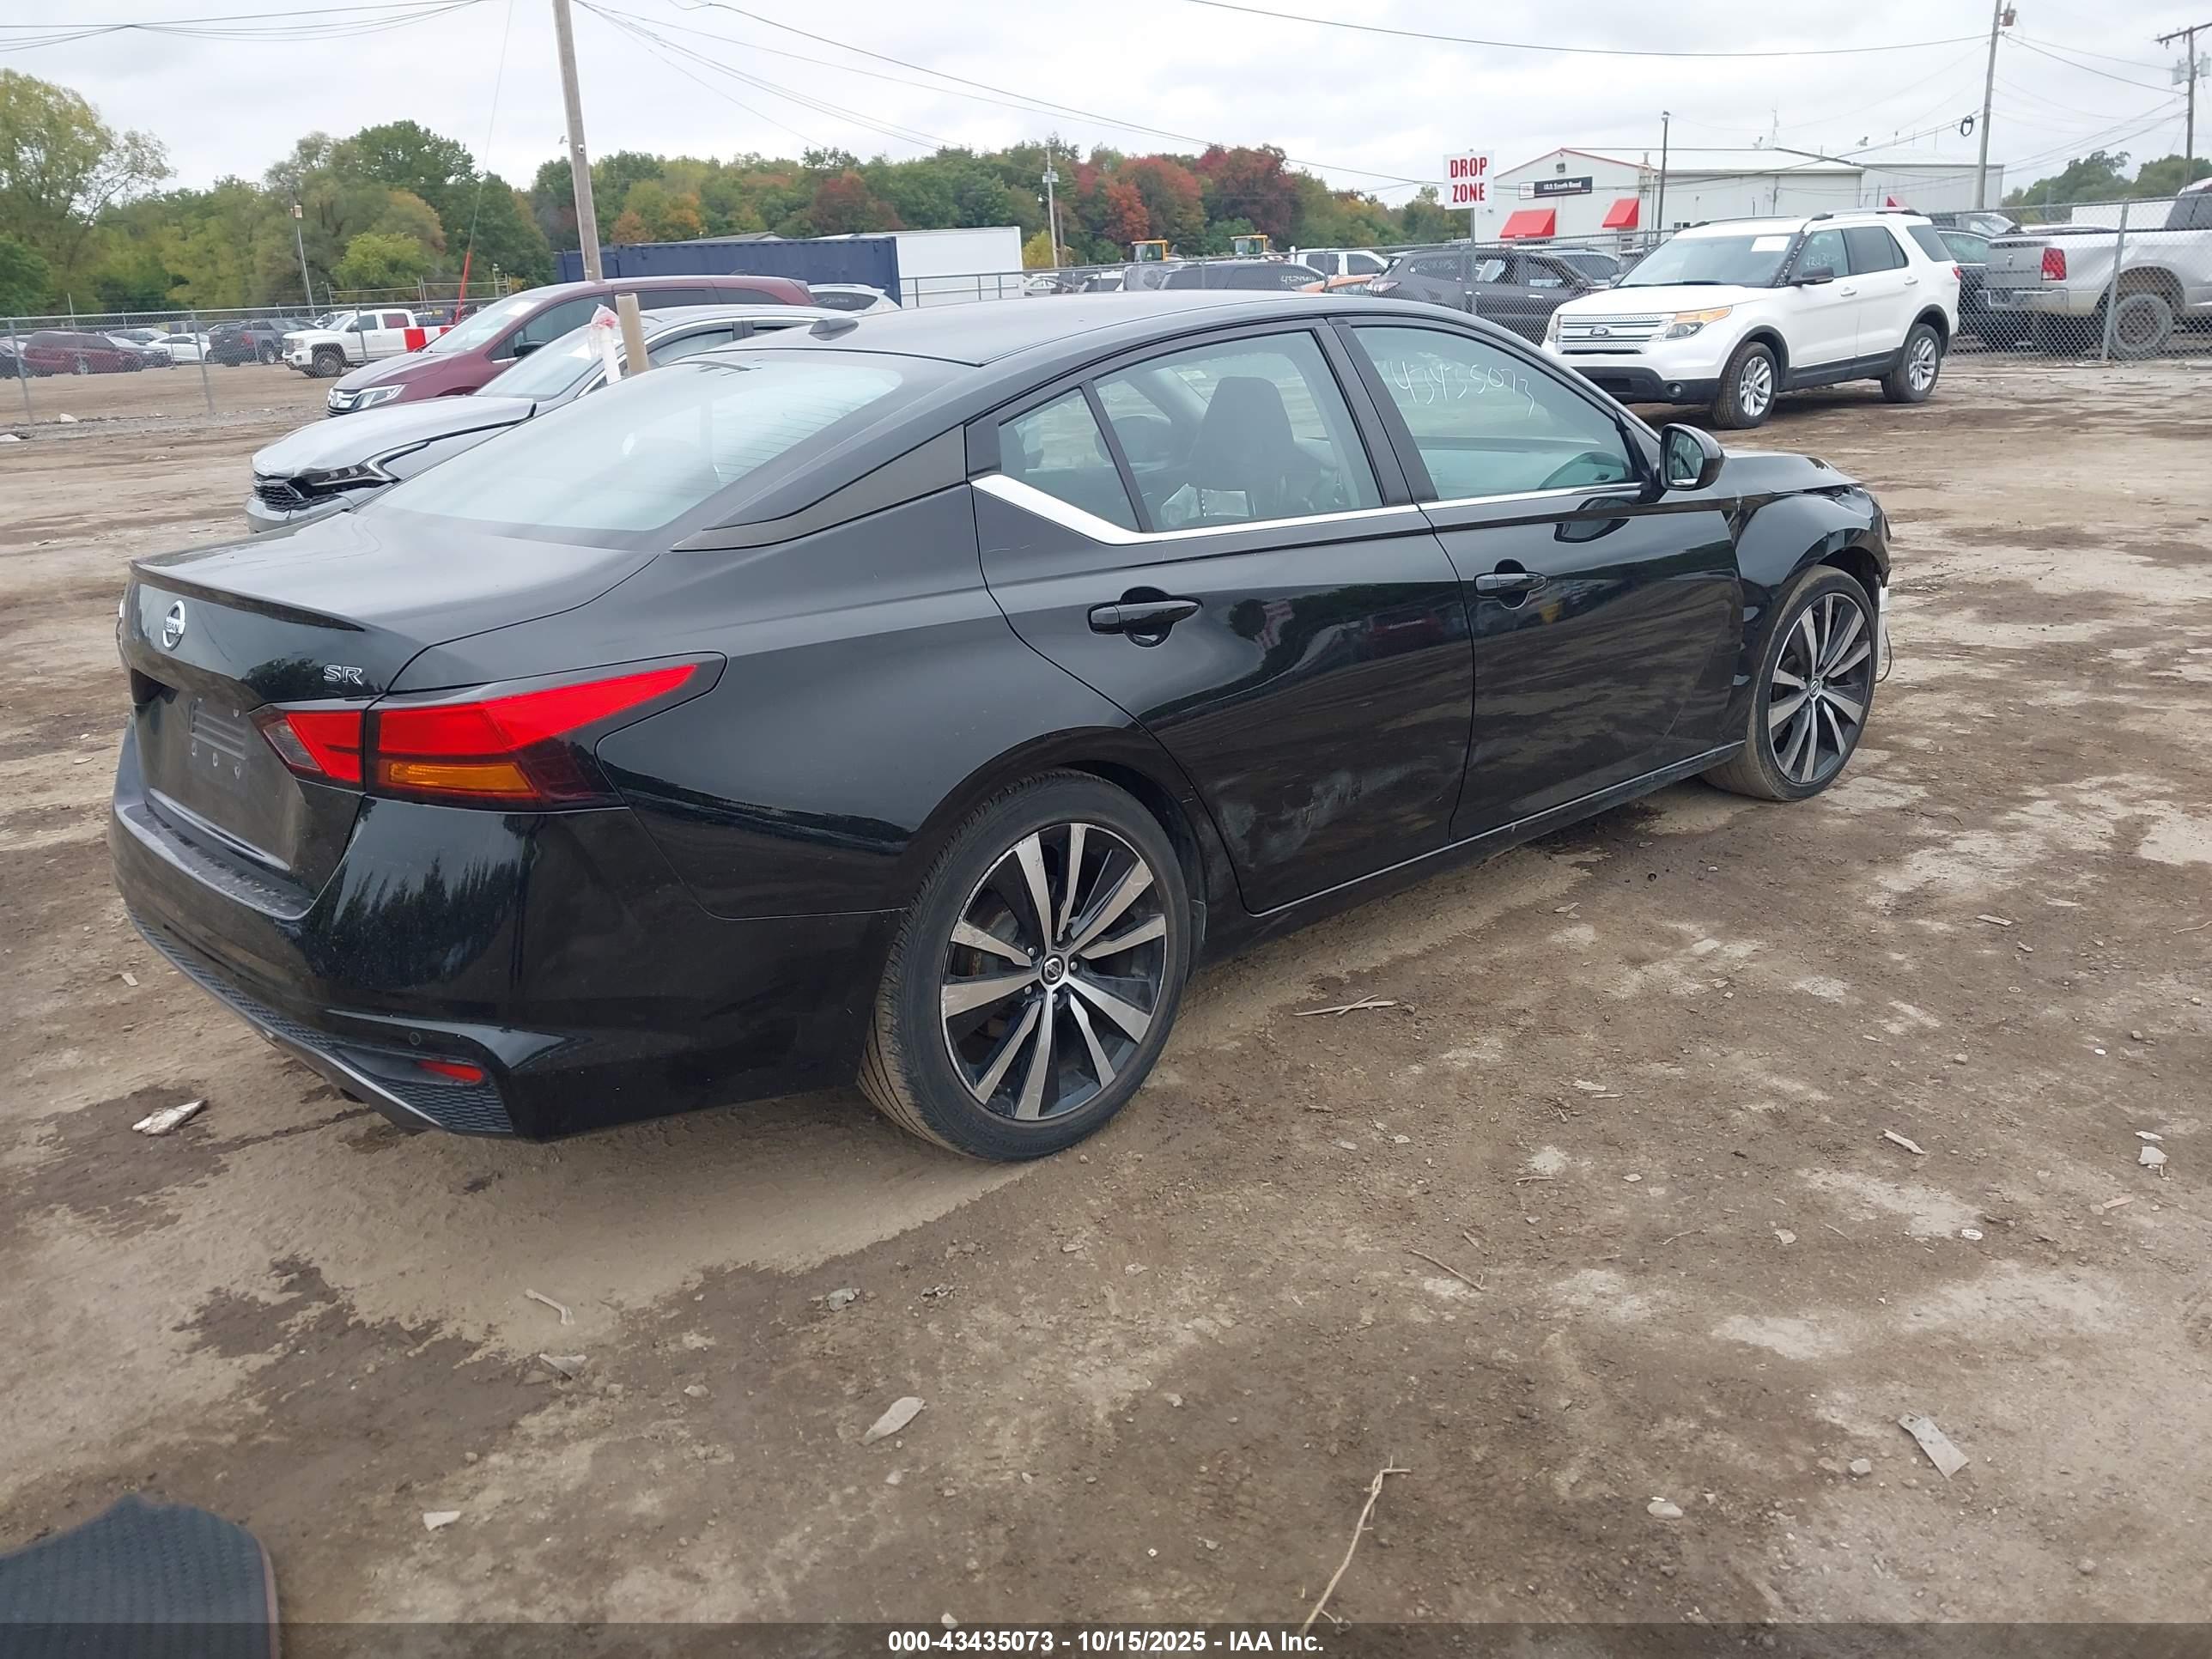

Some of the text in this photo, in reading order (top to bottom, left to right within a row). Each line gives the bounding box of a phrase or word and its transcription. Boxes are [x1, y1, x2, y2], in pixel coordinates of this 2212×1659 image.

[1449, 156, 1487, 179] DROP
[1452, 182, 1486, 204] ZONE
[323, 664, 363, 686] SR
